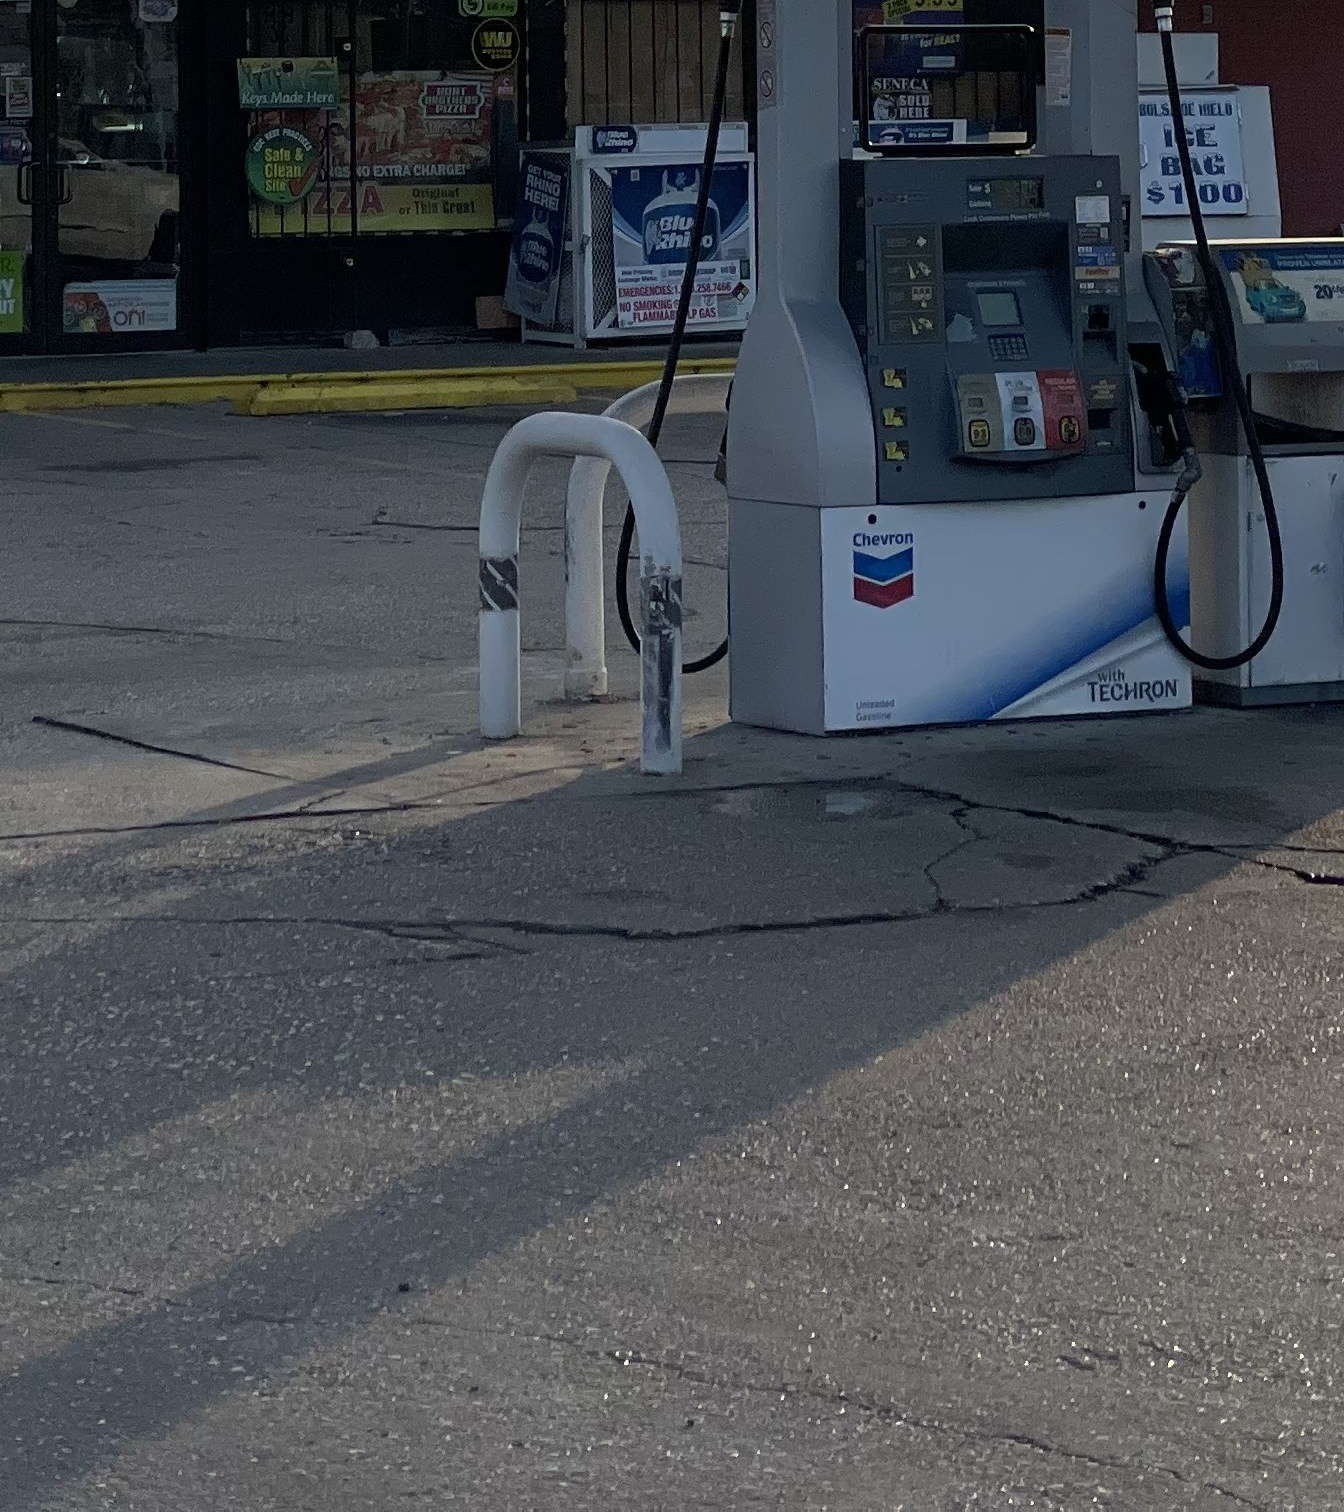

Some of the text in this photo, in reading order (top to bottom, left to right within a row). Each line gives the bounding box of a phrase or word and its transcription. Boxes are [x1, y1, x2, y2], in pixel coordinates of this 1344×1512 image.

[873, 77, 929, 90] SENECA
[241, 90, 335, 106] Keys Made Here
[1139, 102, 1172, 117] BOLS
[294, 147, 304, 162] &
[264, 162, 303, 178] Clean
[373, 164, 412, 177] EXTRA
[526, 173, 561, 197] RHINO
[1147, 180, 1244, 205] $100
[659, 214, 695, 232] Blu
[656, 230, 713, 251] Rhio
[633, 299, 673, 312] SMOKING
[633, 309, 677, 323] FLAMMAB
[698, 307, 717, 319] GAS
[852, 532, 914, 549] Chevron
[1096, 669, 1126, 684] with
[1086, 678, 1179, 703] TECHRON
